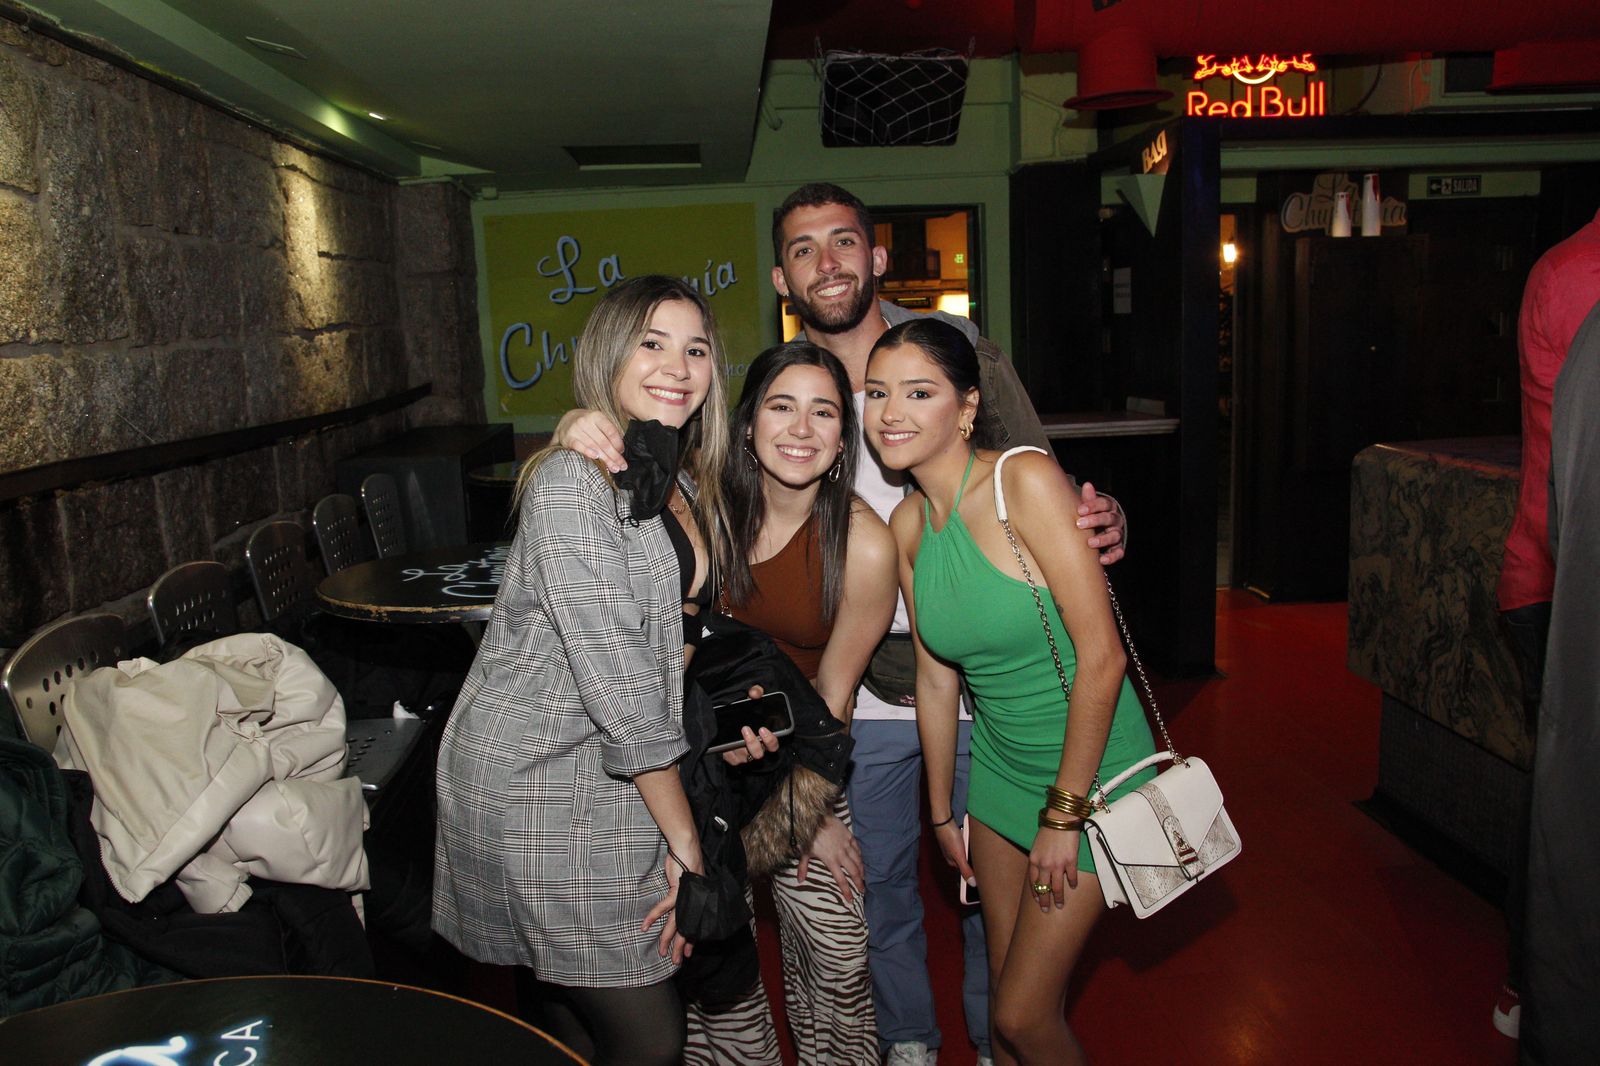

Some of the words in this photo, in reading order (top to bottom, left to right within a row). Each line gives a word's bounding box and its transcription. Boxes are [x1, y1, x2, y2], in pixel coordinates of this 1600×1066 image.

[1186, 85, 1252, 117] Red
[1260, 81, 1325, 117] Bull
[1453, 178, 1478, 192] SALIDA
[537, 236, 625, 304] La
